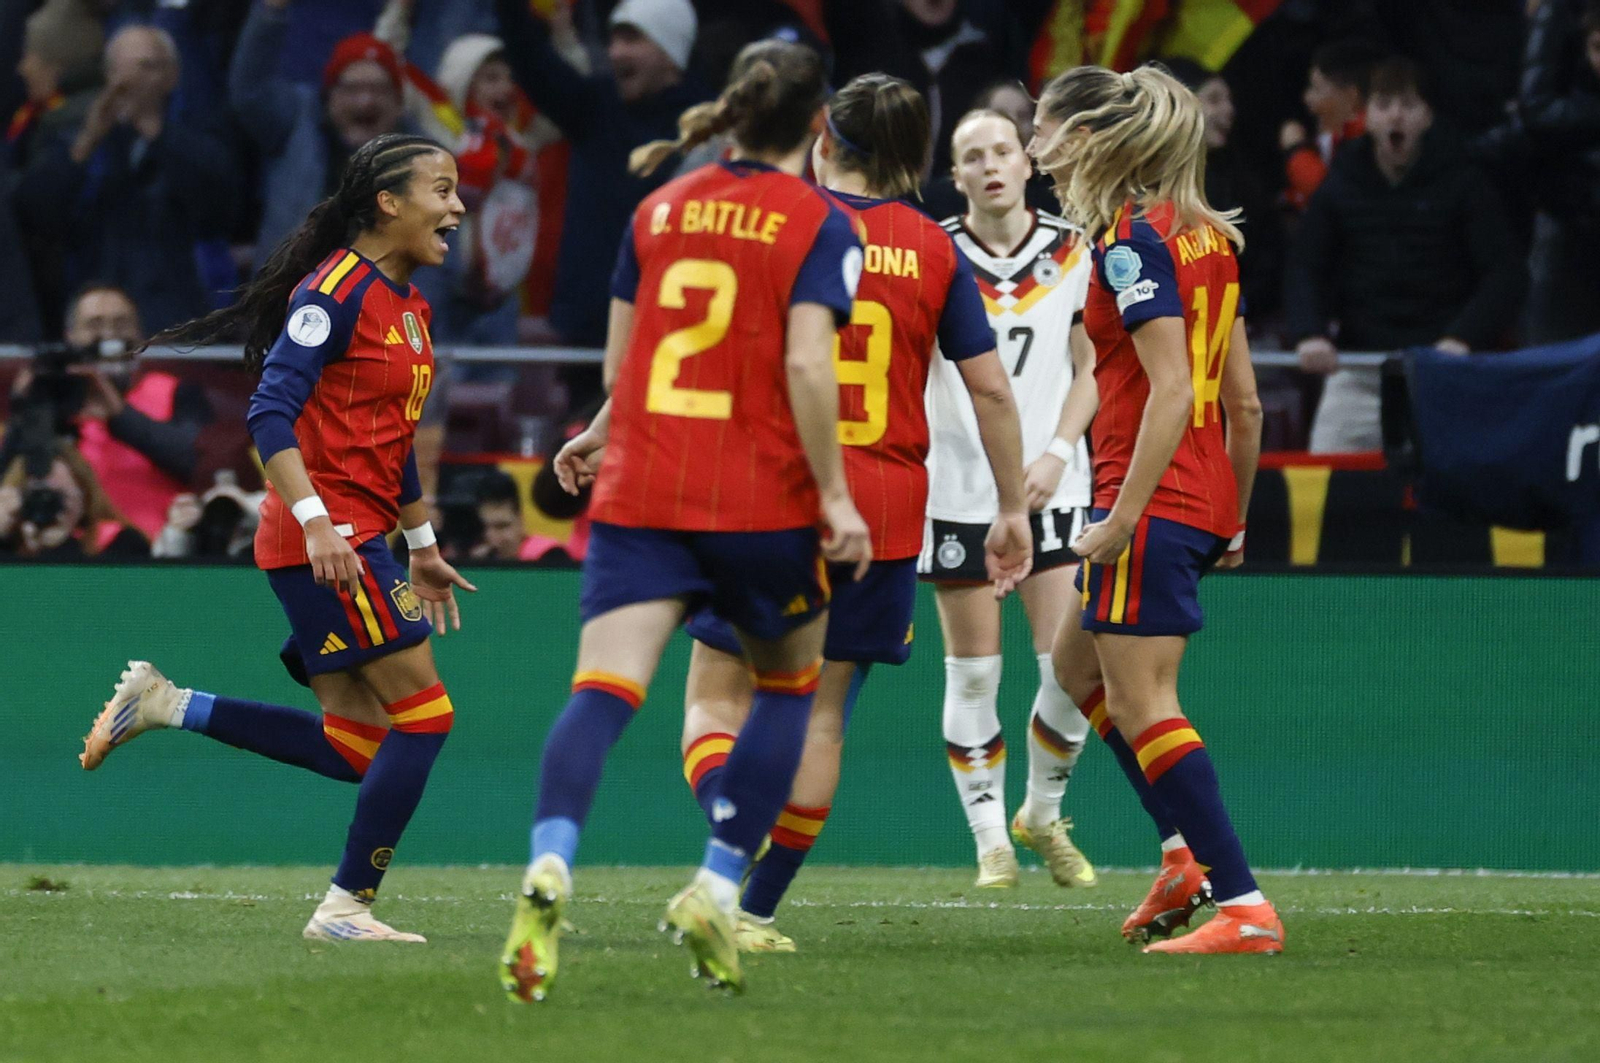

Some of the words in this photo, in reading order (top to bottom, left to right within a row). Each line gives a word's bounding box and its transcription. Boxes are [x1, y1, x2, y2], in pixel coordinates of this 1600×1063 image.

[681, 199, 788, 245] BATLLE
[646, 258, 739, 420] 2
[995, 326, 1034, 377] 7
[1191, 282, 1240, 428] 14
[405, 364, 431, 421] 18
[1040, 506, 1084, 553] 17
